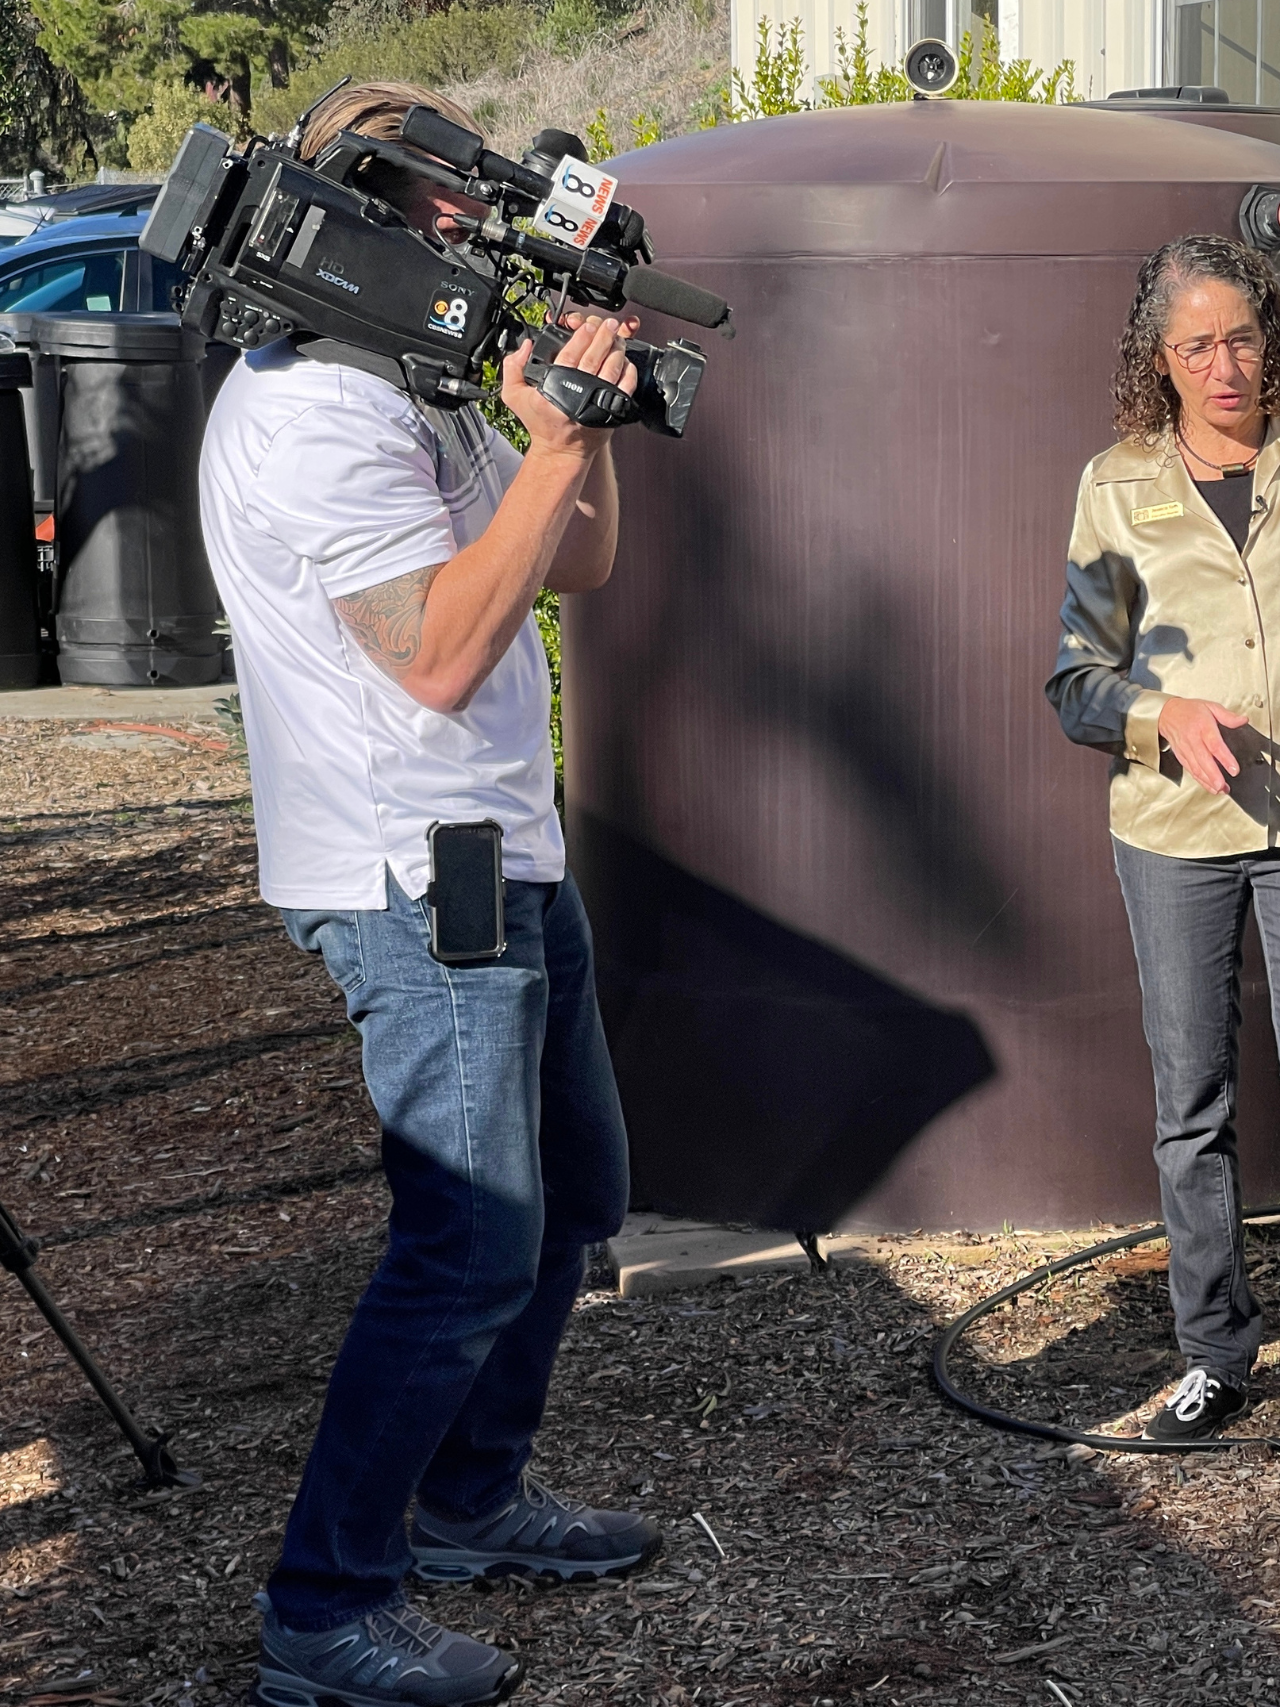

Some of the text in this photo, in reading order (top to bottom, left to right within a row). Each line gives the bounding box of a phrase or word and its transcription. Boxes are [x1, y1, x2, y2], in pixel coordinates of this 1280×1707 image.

[562, 173, 596, 199] 8
[591, 177, 614, 215] NEWS
[544, 210, 579, 233] 8
[572, 217, 598, 246] NEWS
[319, 256, 345, 275] HD
[440, 280, 475, 297] SONY
[443, 298, 469, 331] 8
[560, 380, 584, 394] non
